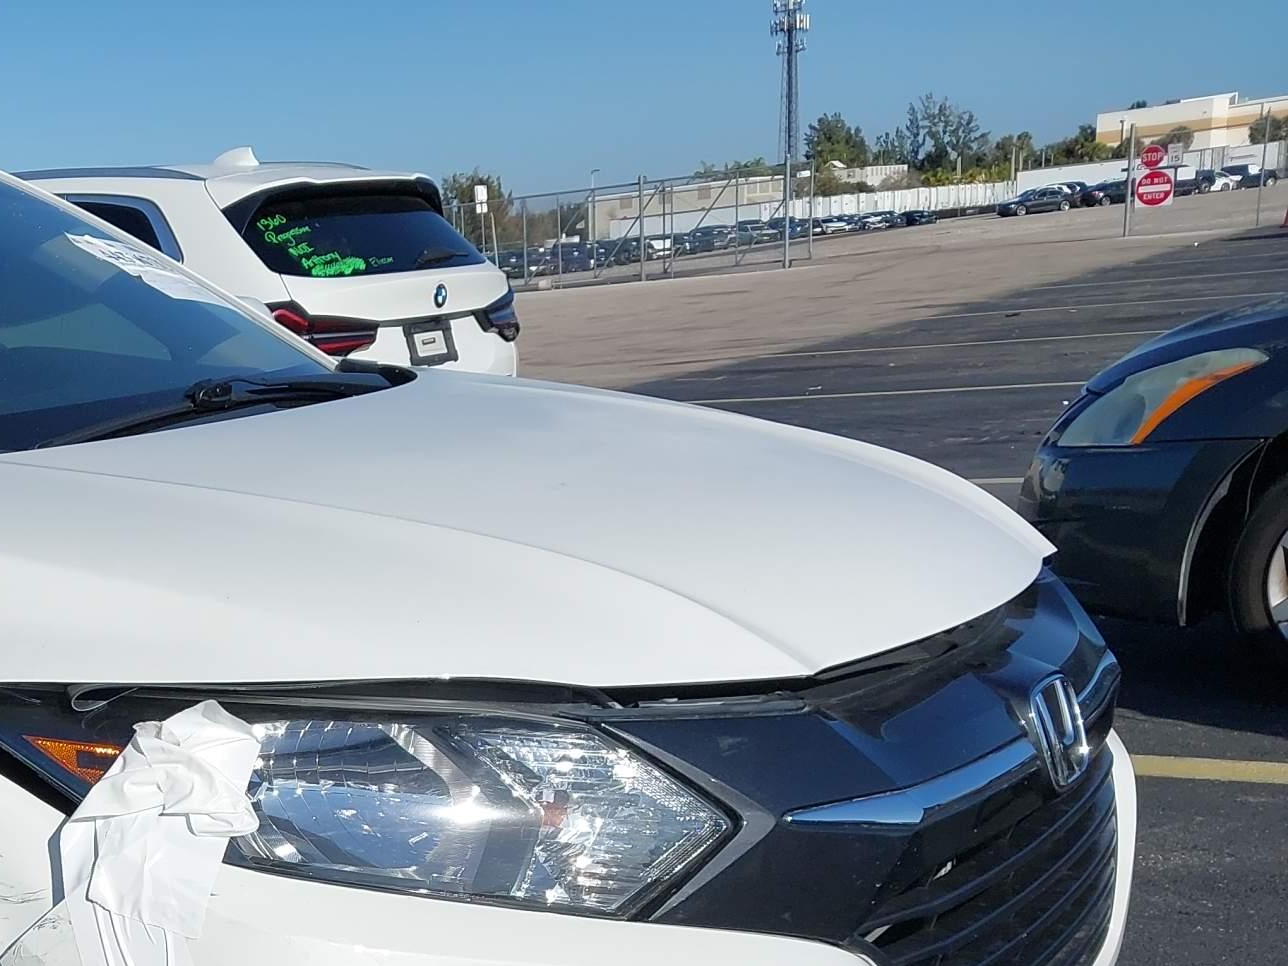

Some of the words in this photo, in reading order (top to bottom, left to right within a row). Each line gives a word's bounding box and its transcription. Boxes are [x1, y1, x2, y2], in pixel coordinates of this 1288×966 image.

[1142, 152, 1164, 163] STOP
[1171, 154, 1180, 162] 15
[1153, 176, 1168, 184] NOT
[1143, 192, 1165, 200] ENTER
